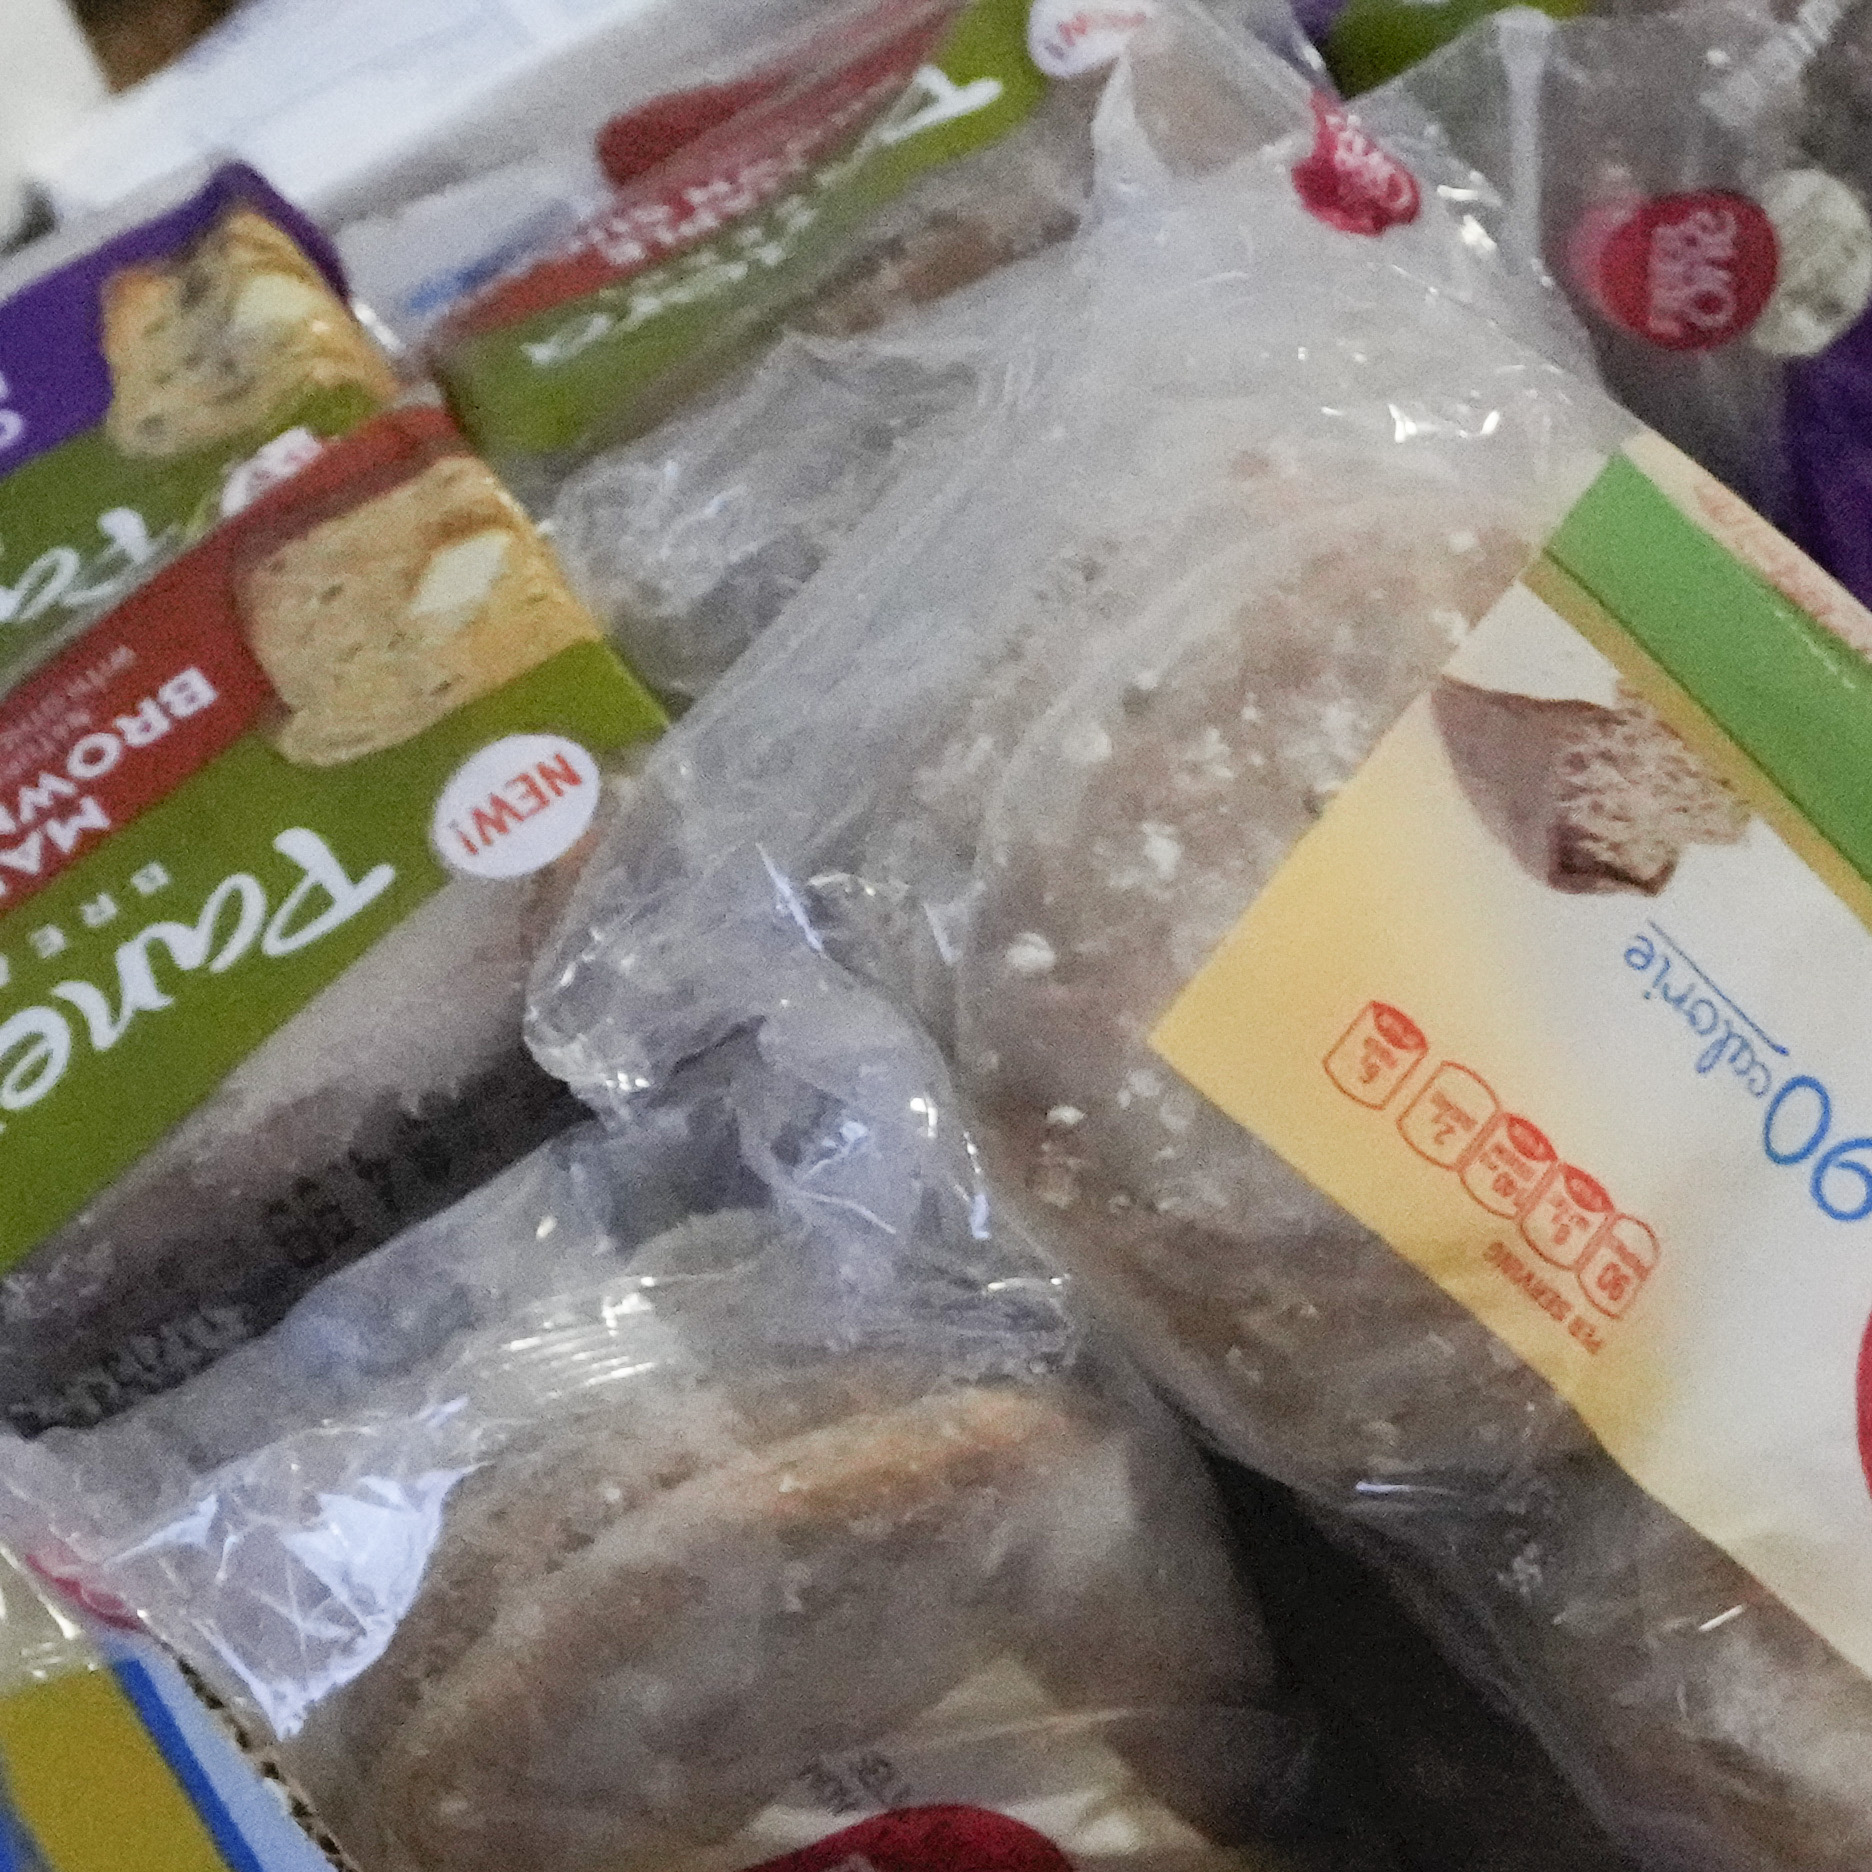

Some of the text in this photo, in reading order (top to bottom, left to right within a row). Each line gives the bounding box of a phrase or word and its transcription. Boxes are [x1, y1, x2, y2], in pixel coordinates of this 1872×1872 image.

[0, 794, 113, 882] MA
[457, 752, 584, 859] NEW!
[0, 827, 396, 1112] Pane
[1622, 934, 1775, 1099] calorie
